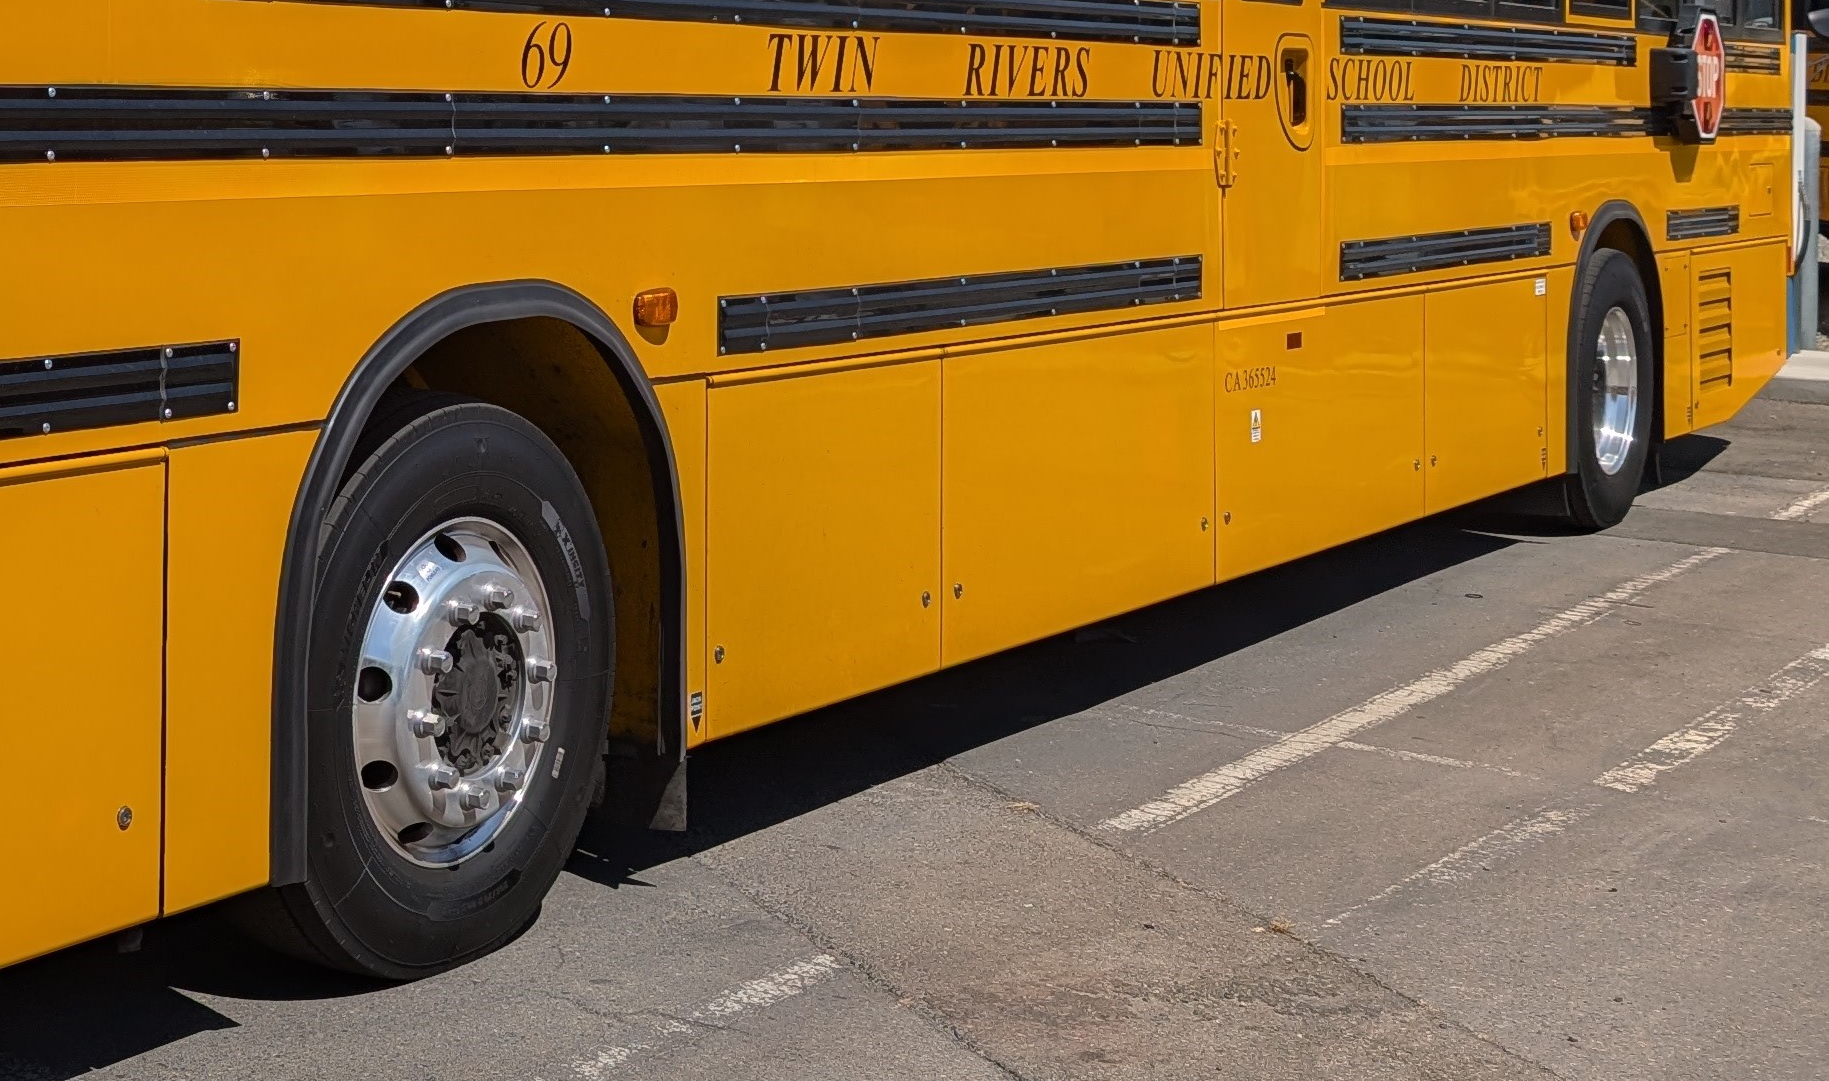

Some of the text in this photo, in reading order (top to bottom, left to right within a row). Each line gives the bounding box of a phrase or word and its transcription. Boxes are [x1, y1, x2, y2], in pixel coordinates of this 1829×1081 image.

[522, 21, 1543, 103] 69 TWIN RIVERS UNIFIED SCHOOL DISTRICT
[1225, 366, 1276, 393] CA 365524
